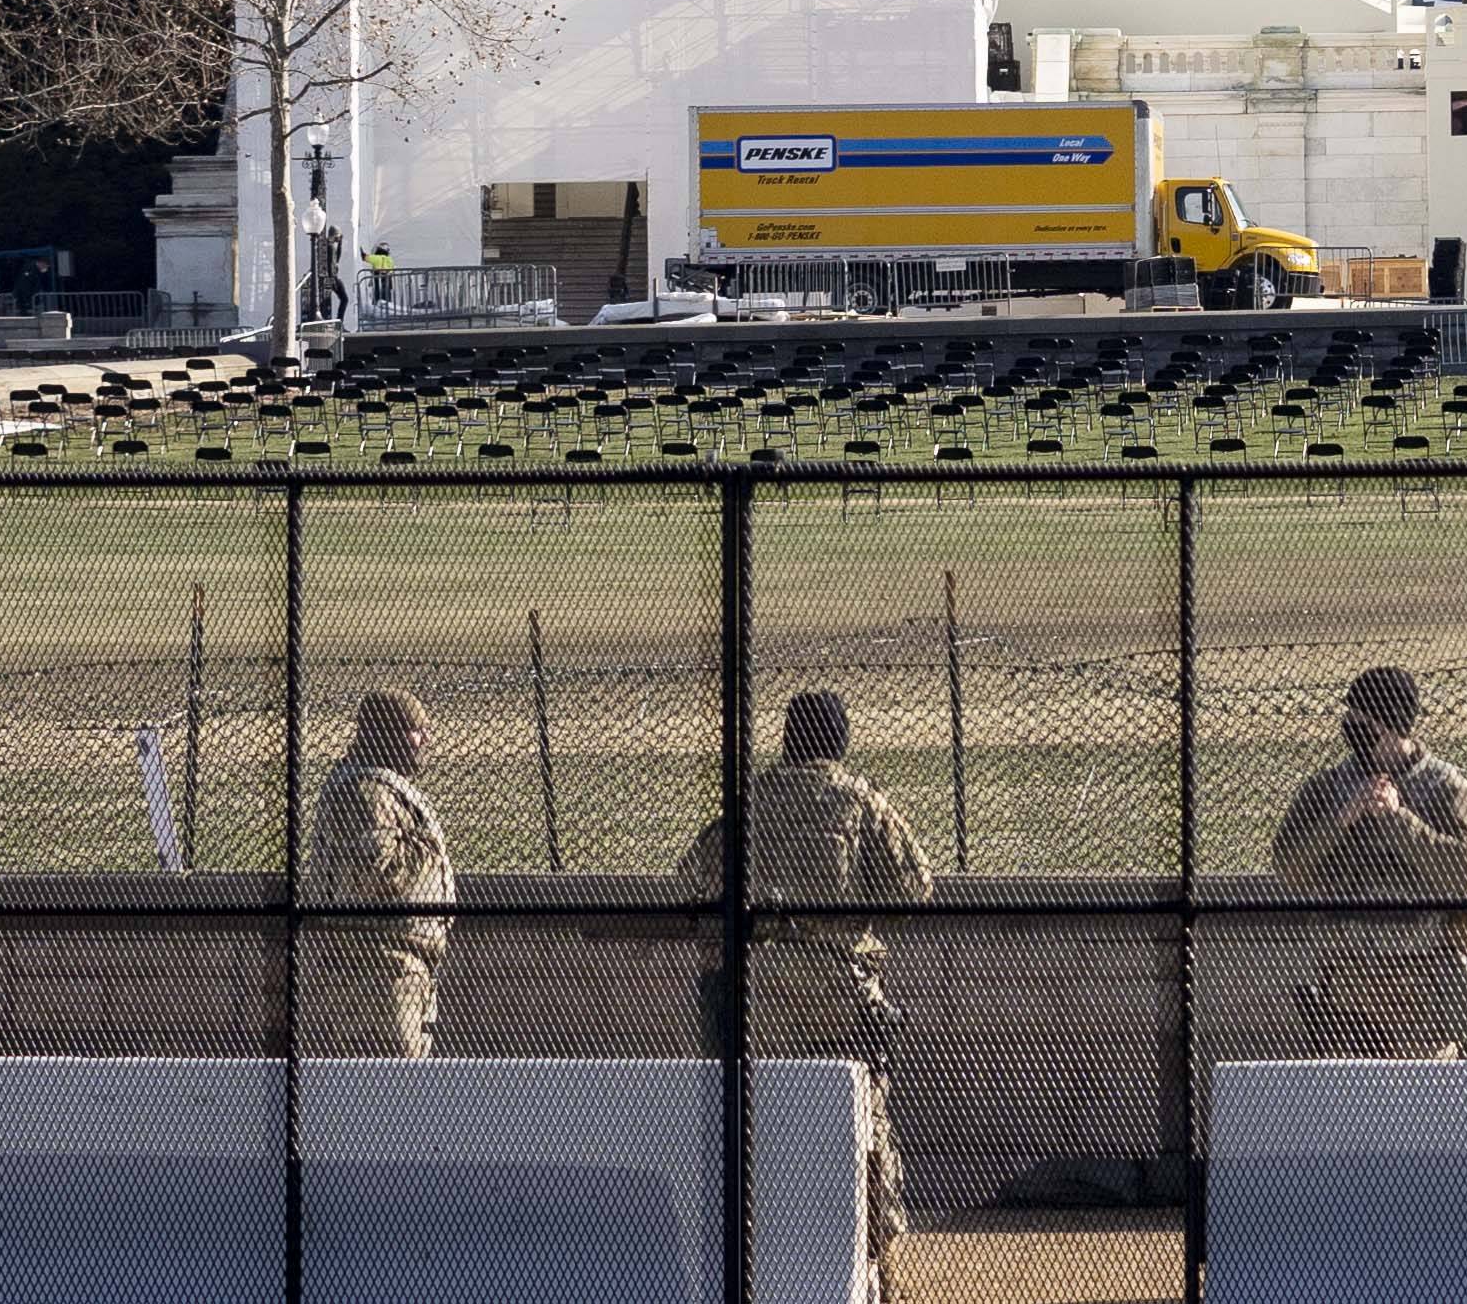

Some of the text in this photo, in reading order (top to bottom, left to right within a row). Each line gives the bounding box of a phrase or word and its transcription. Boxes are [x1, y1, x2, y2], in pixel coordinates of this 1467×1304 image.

[1059, 138, 1085, 147] Local
[744, 147, 829, 161] PENSKE
[1052, 153, 1091, 163] One Way
[757, 174, 821, 185] Truck Rental
[756, 223, 816, 232] GoPenske.com
